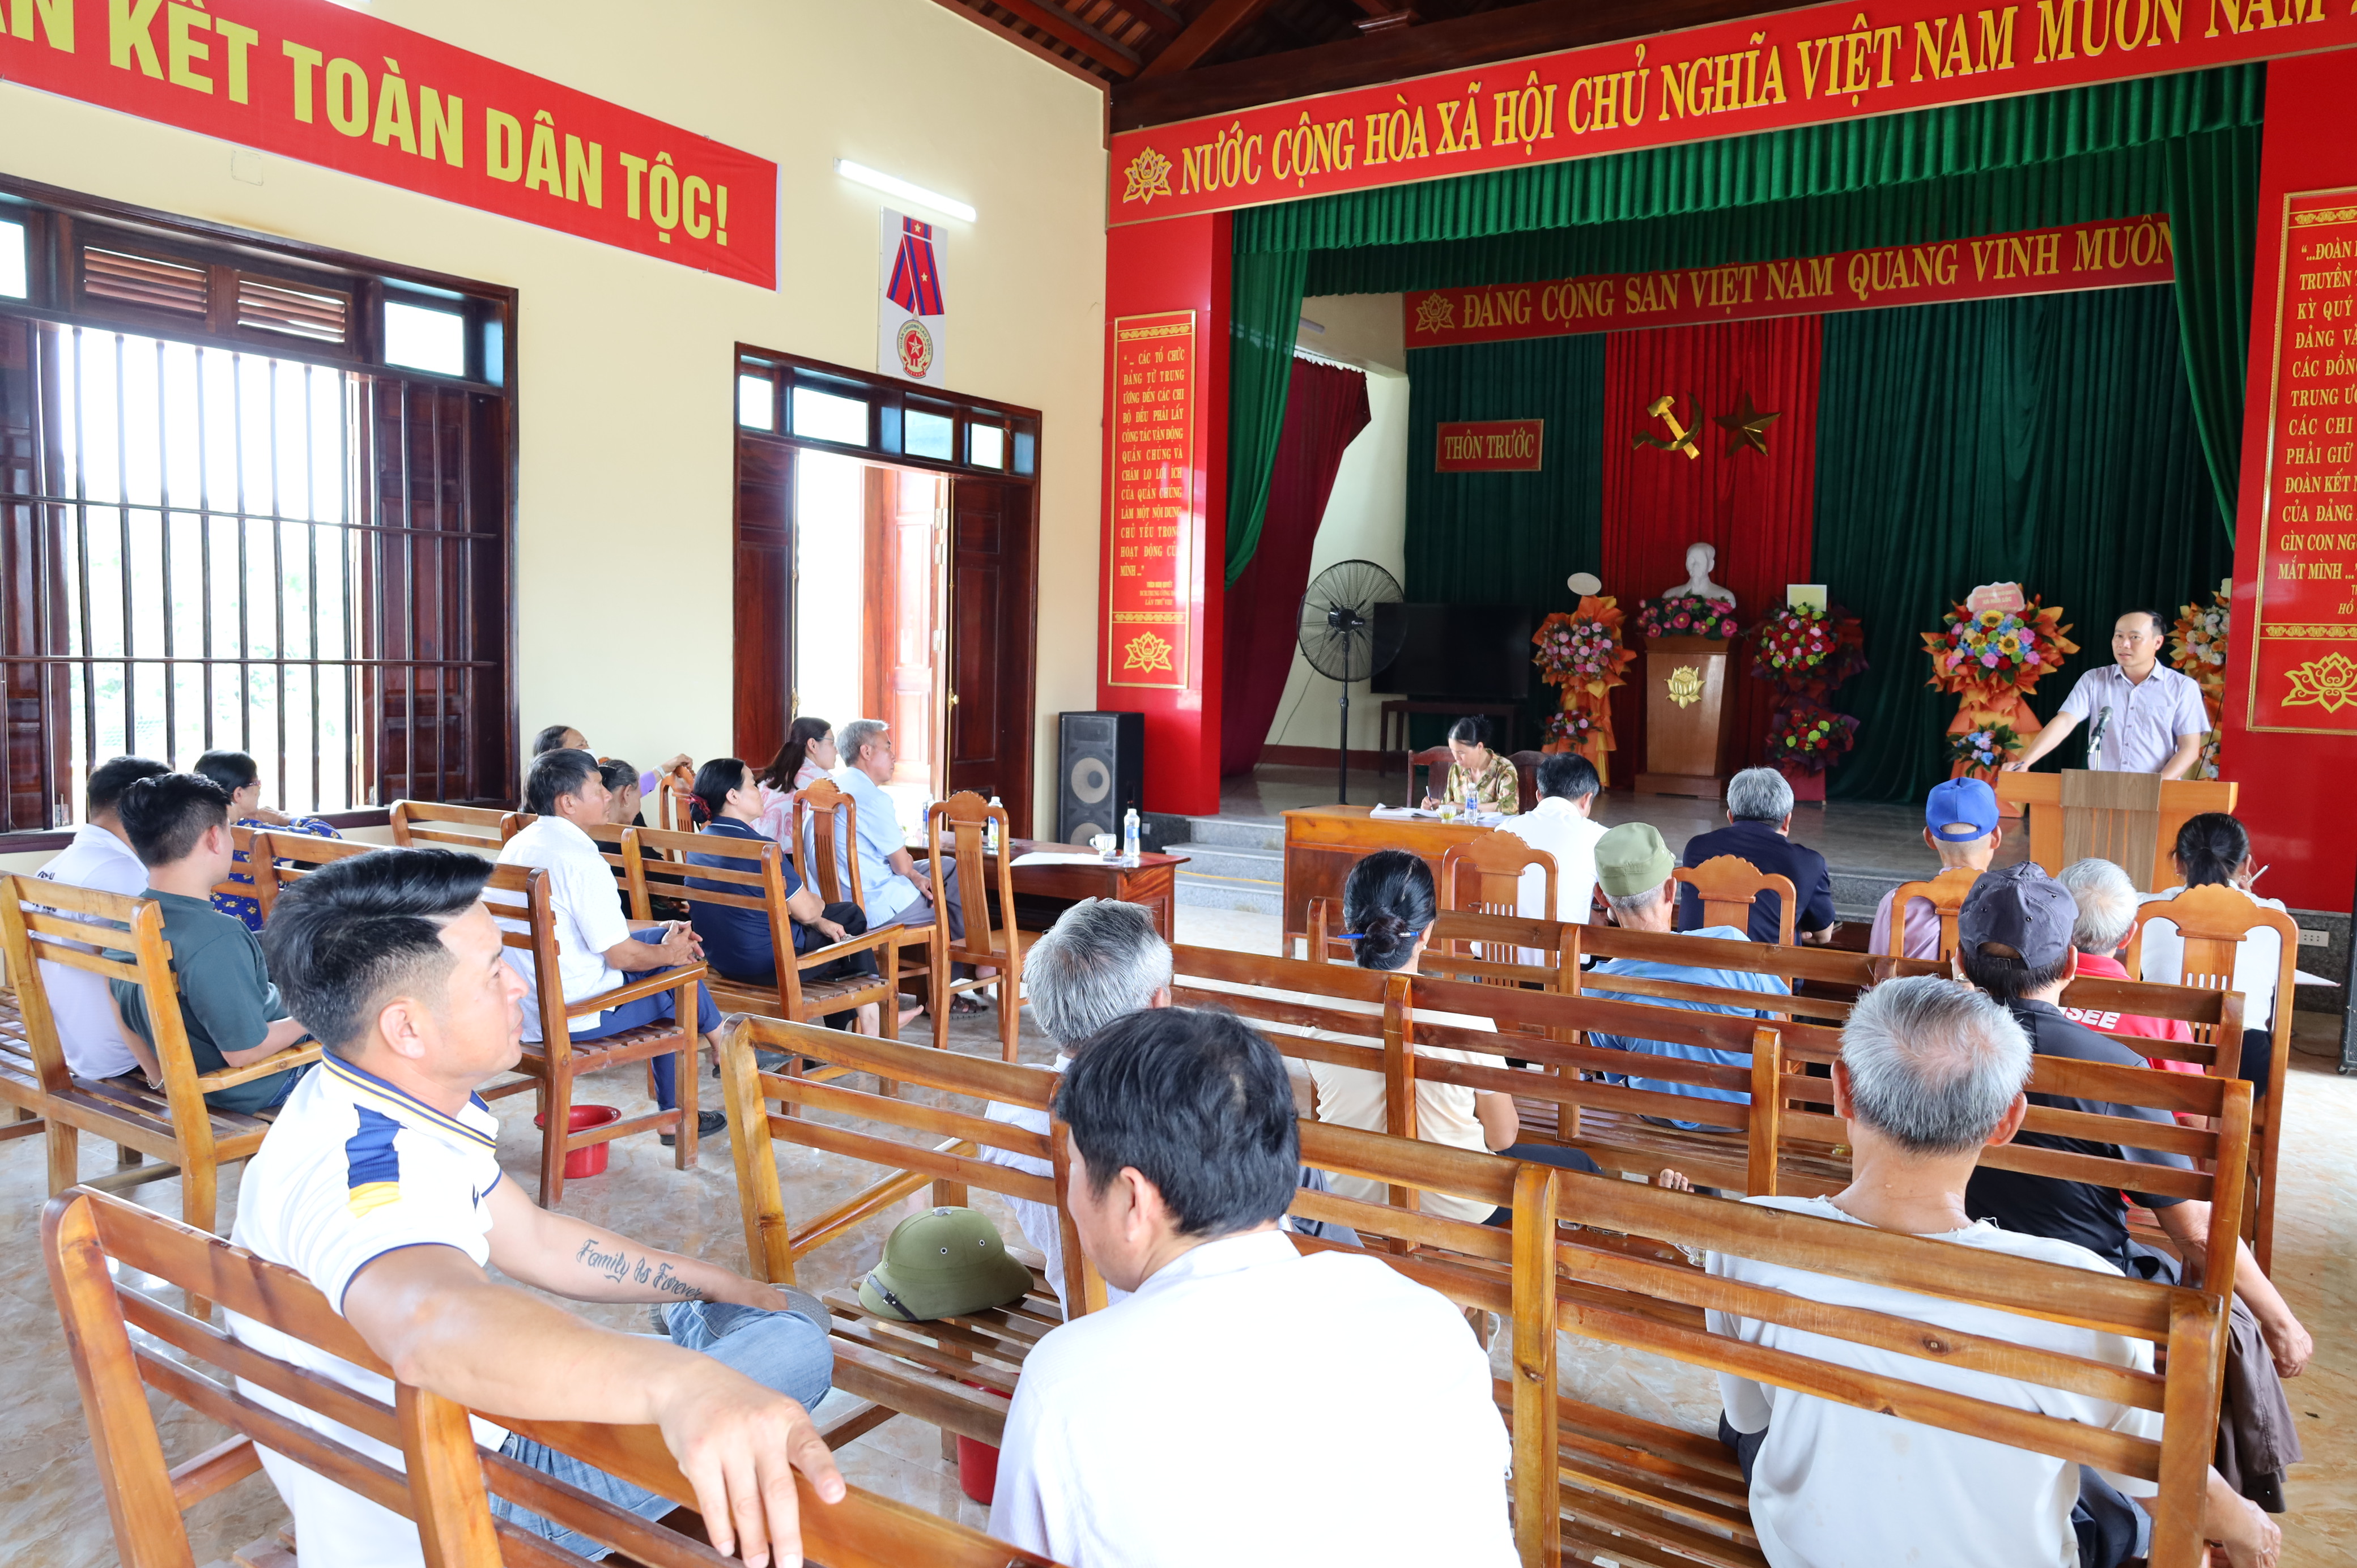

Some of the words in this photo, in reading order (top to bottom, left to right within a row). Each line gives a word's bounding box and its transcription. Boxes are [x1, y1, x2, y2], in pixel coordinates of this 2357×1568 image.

[1180, 120, 1263, 194] NƯỚC
[1271, 110, 1355, 188] CỘNG
[1363, 93, 1428, 165] HÒA
[1436, 81, 1483, 155] XÃ
[1492, 70, 1558, 156] HỘI
[1568, 44, 1649, 135] CHỦ
[1659, 31, 1787, 121] NGHĨA
[1797, 12, 1901, 108] VIỆT
[1910, 5, 2019, 83] NAM
[283, 40, 463, 168] TOÀN
[486, 107, 602, 208] DÂN
[619, 150, 728, 246] TỘC!
[1542, 276, 1614, 328] CỘNG
[1765, 257, 1835, 301] NAM
[1848, 244, 1958, 301] QUANG
[1971, 233, 2061, 282] VINH
[2299, 262, 2352, 290] TRUYỀN
[2297, 297, 2316, 319] KỲ
[2323, 295, 2353, 321] QUÝ
[2295, 325, 2334, 348] ĐẢNG
[1138, 350, 1151, 365] CÁC
[1155, 346, 1163, 363] TỔ
[2292, 356, 2319, 377] CÁC
[2325, 350, 2357, 376] ĐỒN
[1124, 369, 1142, 385] ĐẢNG
[1160, 369, 1185, 382] TRUNG
[1123, 390, 1140, 404] ƯƠNG
[1142, 386, 1155, 403] ĐẾN
[1158, 386, 1170, 402] CÁC
[1172, 388, 1184, 400] CHI
[2291, 387, 2338, 406] TRUNG
[1123, 409, 1131, 426] BỘ
[1152, 404, 1168, 421] PHẢI
[1171, 403, 1184, 420] LẤY
[2288, 414, 2317, 436] CÁC
[2325, 417, 2352, 434] CHI
[1122, 428, 1138, 442] CÔNG
[1139, 427, 1151, 441] TÁC
[1152, 426, 1165, 443] VẬN
[1165, 425, 1184, 442] ĐỘNG
[1445, 429, 1483, 459] THÔN
[1486, 427, 1534, 458] TRƯỚC
[1122, 444, 1141, 465] QUẦN
[1146, 445, 1171, 461] CHÚNG
[1174, 444, 1183, 459] VÀ
[2286, 441, 2321, 465] PHẢI
[2327, 442, 2354, 463] GIỮ
[1143, 468, 1152, 480] LO
[1171, 464, 1182, 479] ÍCH
[2284, 472, 2320, 493] ĐOÀN
[2324, 468, 2351, 492] KẾT
[1121, 484, 1134, 500] CỦA
[1137, 482, 1156, 502] QUẦN
[1159, 484, 1182, 499] CHÚNG
[1121, 505, 1134, 519] LÀM
[1137, 504, 1150, 521] MỘT
[1152, 504, 1163, 521] NỘI
[1164, 506, 1182, 518] DUNG
[2282, 499, 2308, 522] CỦA
[2316, 498, 2353, 522] ĐẢNG
[1121, 522, 1135, 538] CHỦ
[1139, 522, 1154, 538] YẾU
[2281, 530, 2304, 551] GÌN
[2307, 534, 2335, 551] CON
[1120, 546, 1138, 560] HOẠT
[1143, 543, 1163, 560] ĐỘNG
[1167, 540, 1181, 557] CỦ
[1120, 562, 1136, 577] MÌNH
[2278, 554, 2305, 580] MẮT
[2308, 558, 2342, 580] MÌNH
[576, 1238, 630, 1284] Family
[653, 1263, 703, 1298] Forever
